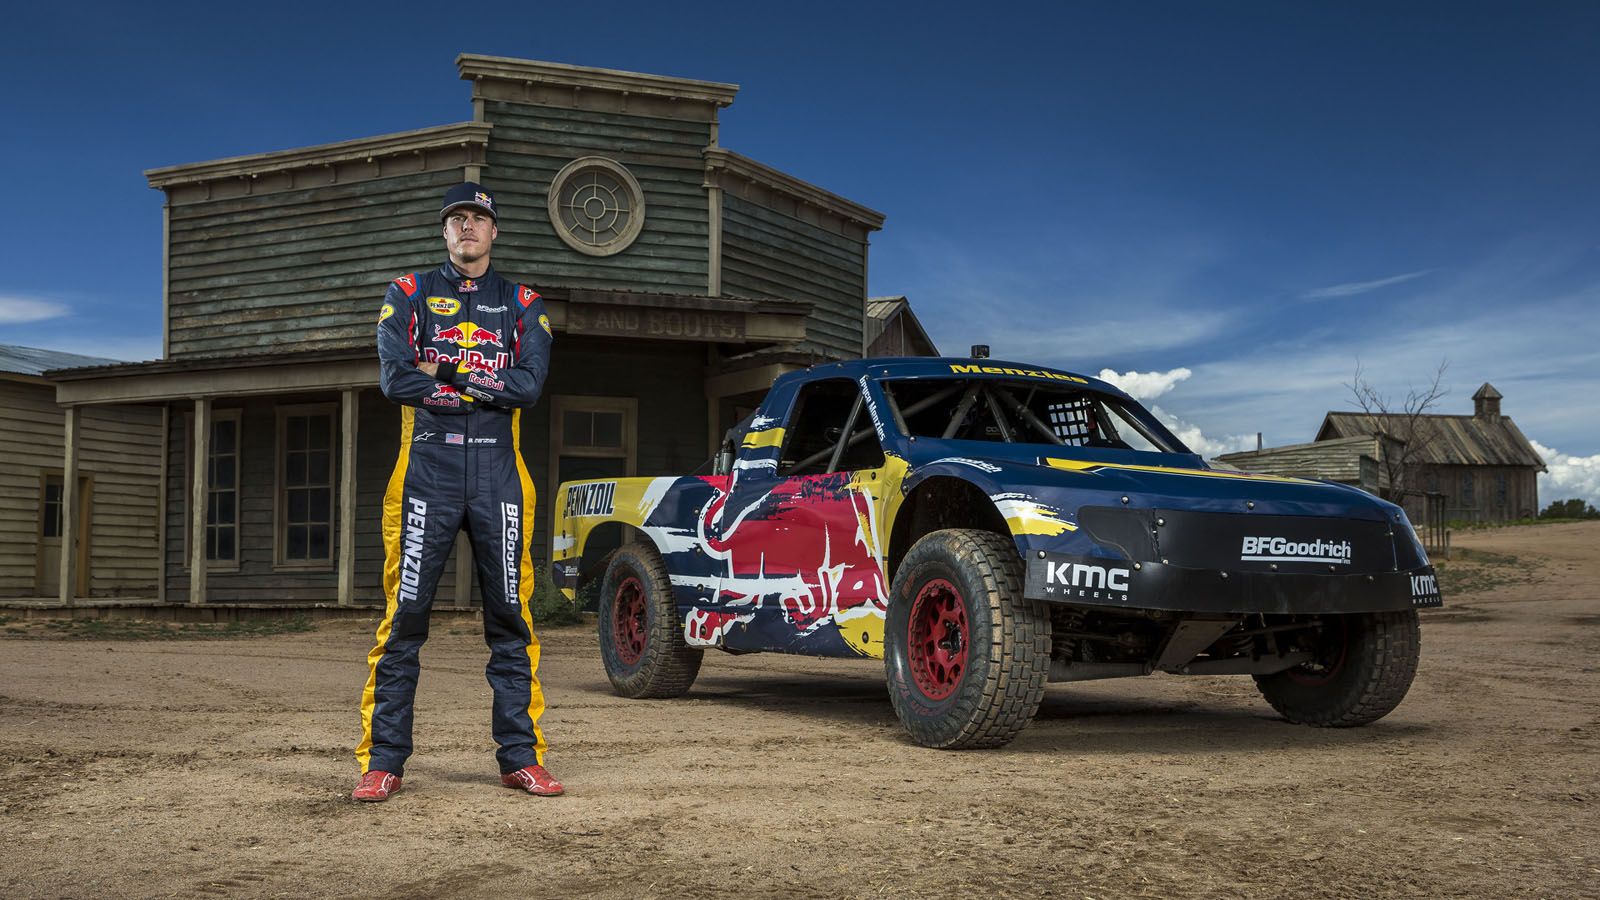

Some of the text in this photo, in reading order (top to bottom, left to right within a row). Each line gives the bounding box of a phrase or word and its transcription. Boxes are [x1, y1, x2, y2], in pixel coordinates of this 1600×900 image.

[595, 311, 639, 330] AND
[424, 347, 466, 364] Red
[469, 373, 504, 391] Red Bull
[949, 364, 1089, 384] Menzies
[424, 397, 459, 407] Red Bull
[565, 482, 617, 517] PENNZOIL
[400, 497, 427, 602] PENNZOIL
[505, 503, 519, 604] BFGoodrich
[1241, 536, 1351, 558] BFGoodrich
[1046, 587, 1128, 601] WHEELS
